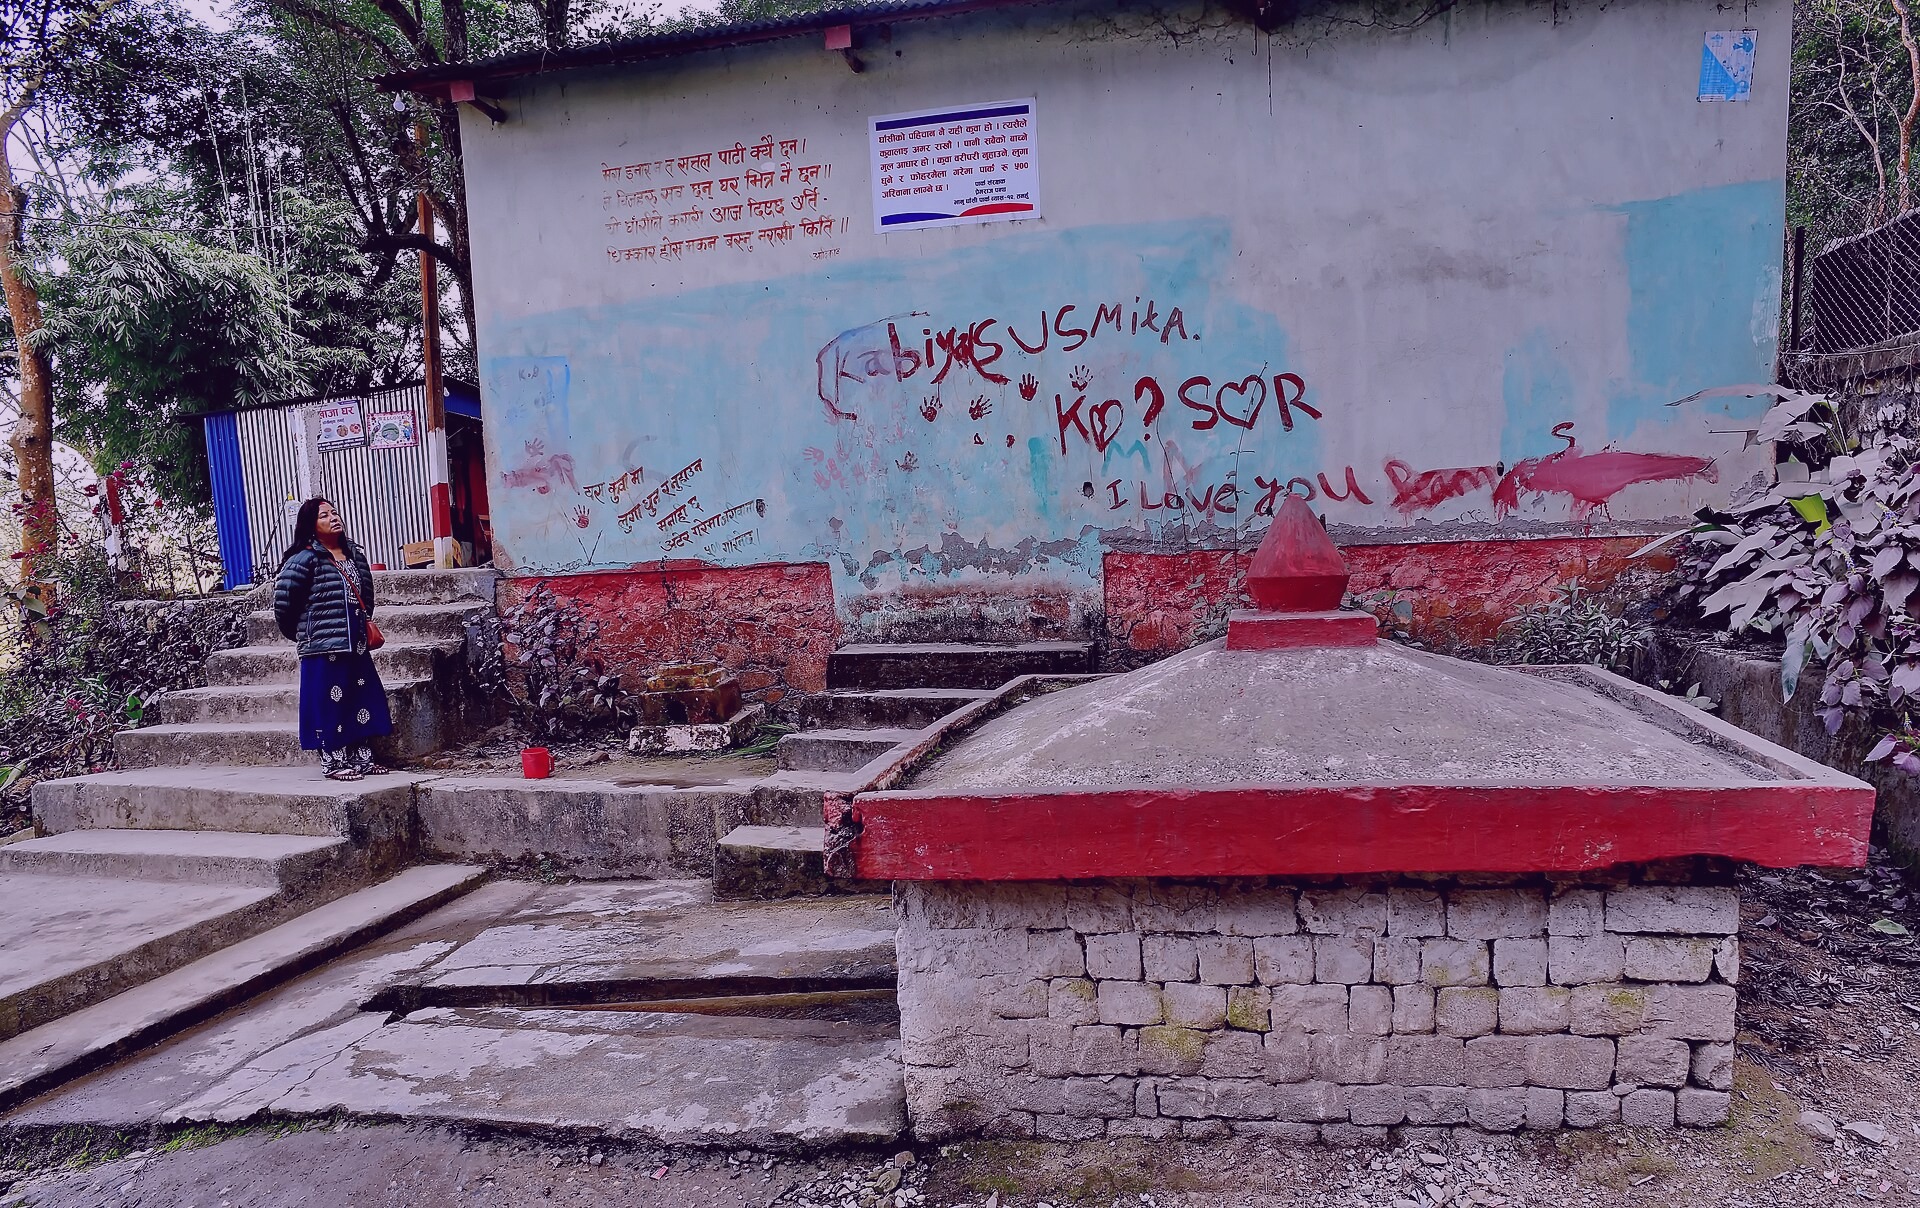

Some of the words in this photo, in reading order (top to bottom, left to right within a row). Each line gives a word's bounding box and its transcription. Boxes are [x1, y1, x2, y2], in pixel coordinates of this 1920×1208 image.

[948, 125, 963, 135] यही
[966, 124, 981, 135] कुवा
[984, 122, 993, 132] हो
[718, 142, 746, 165] पाटी
[912, 144, 931, 154] अमर
[963, 137, 980, 147] पानी
[920, 156, 929, 166] हो
[937, 156, 952, 166] कुवा
[1012, 147, 1028, 157] लुगा
[899, 175, 904, 183] र
[979, 163, 995, 174] पार्क
[1014, 162, 1028, 170] ५००
[719, 177, 740, 196] घर
[882, 187, 911, 199] जरिवाना
[935, 183, 943, 192] छ
[710, 205, 743, 223] आज
[341, 406, 355, 415] घर
